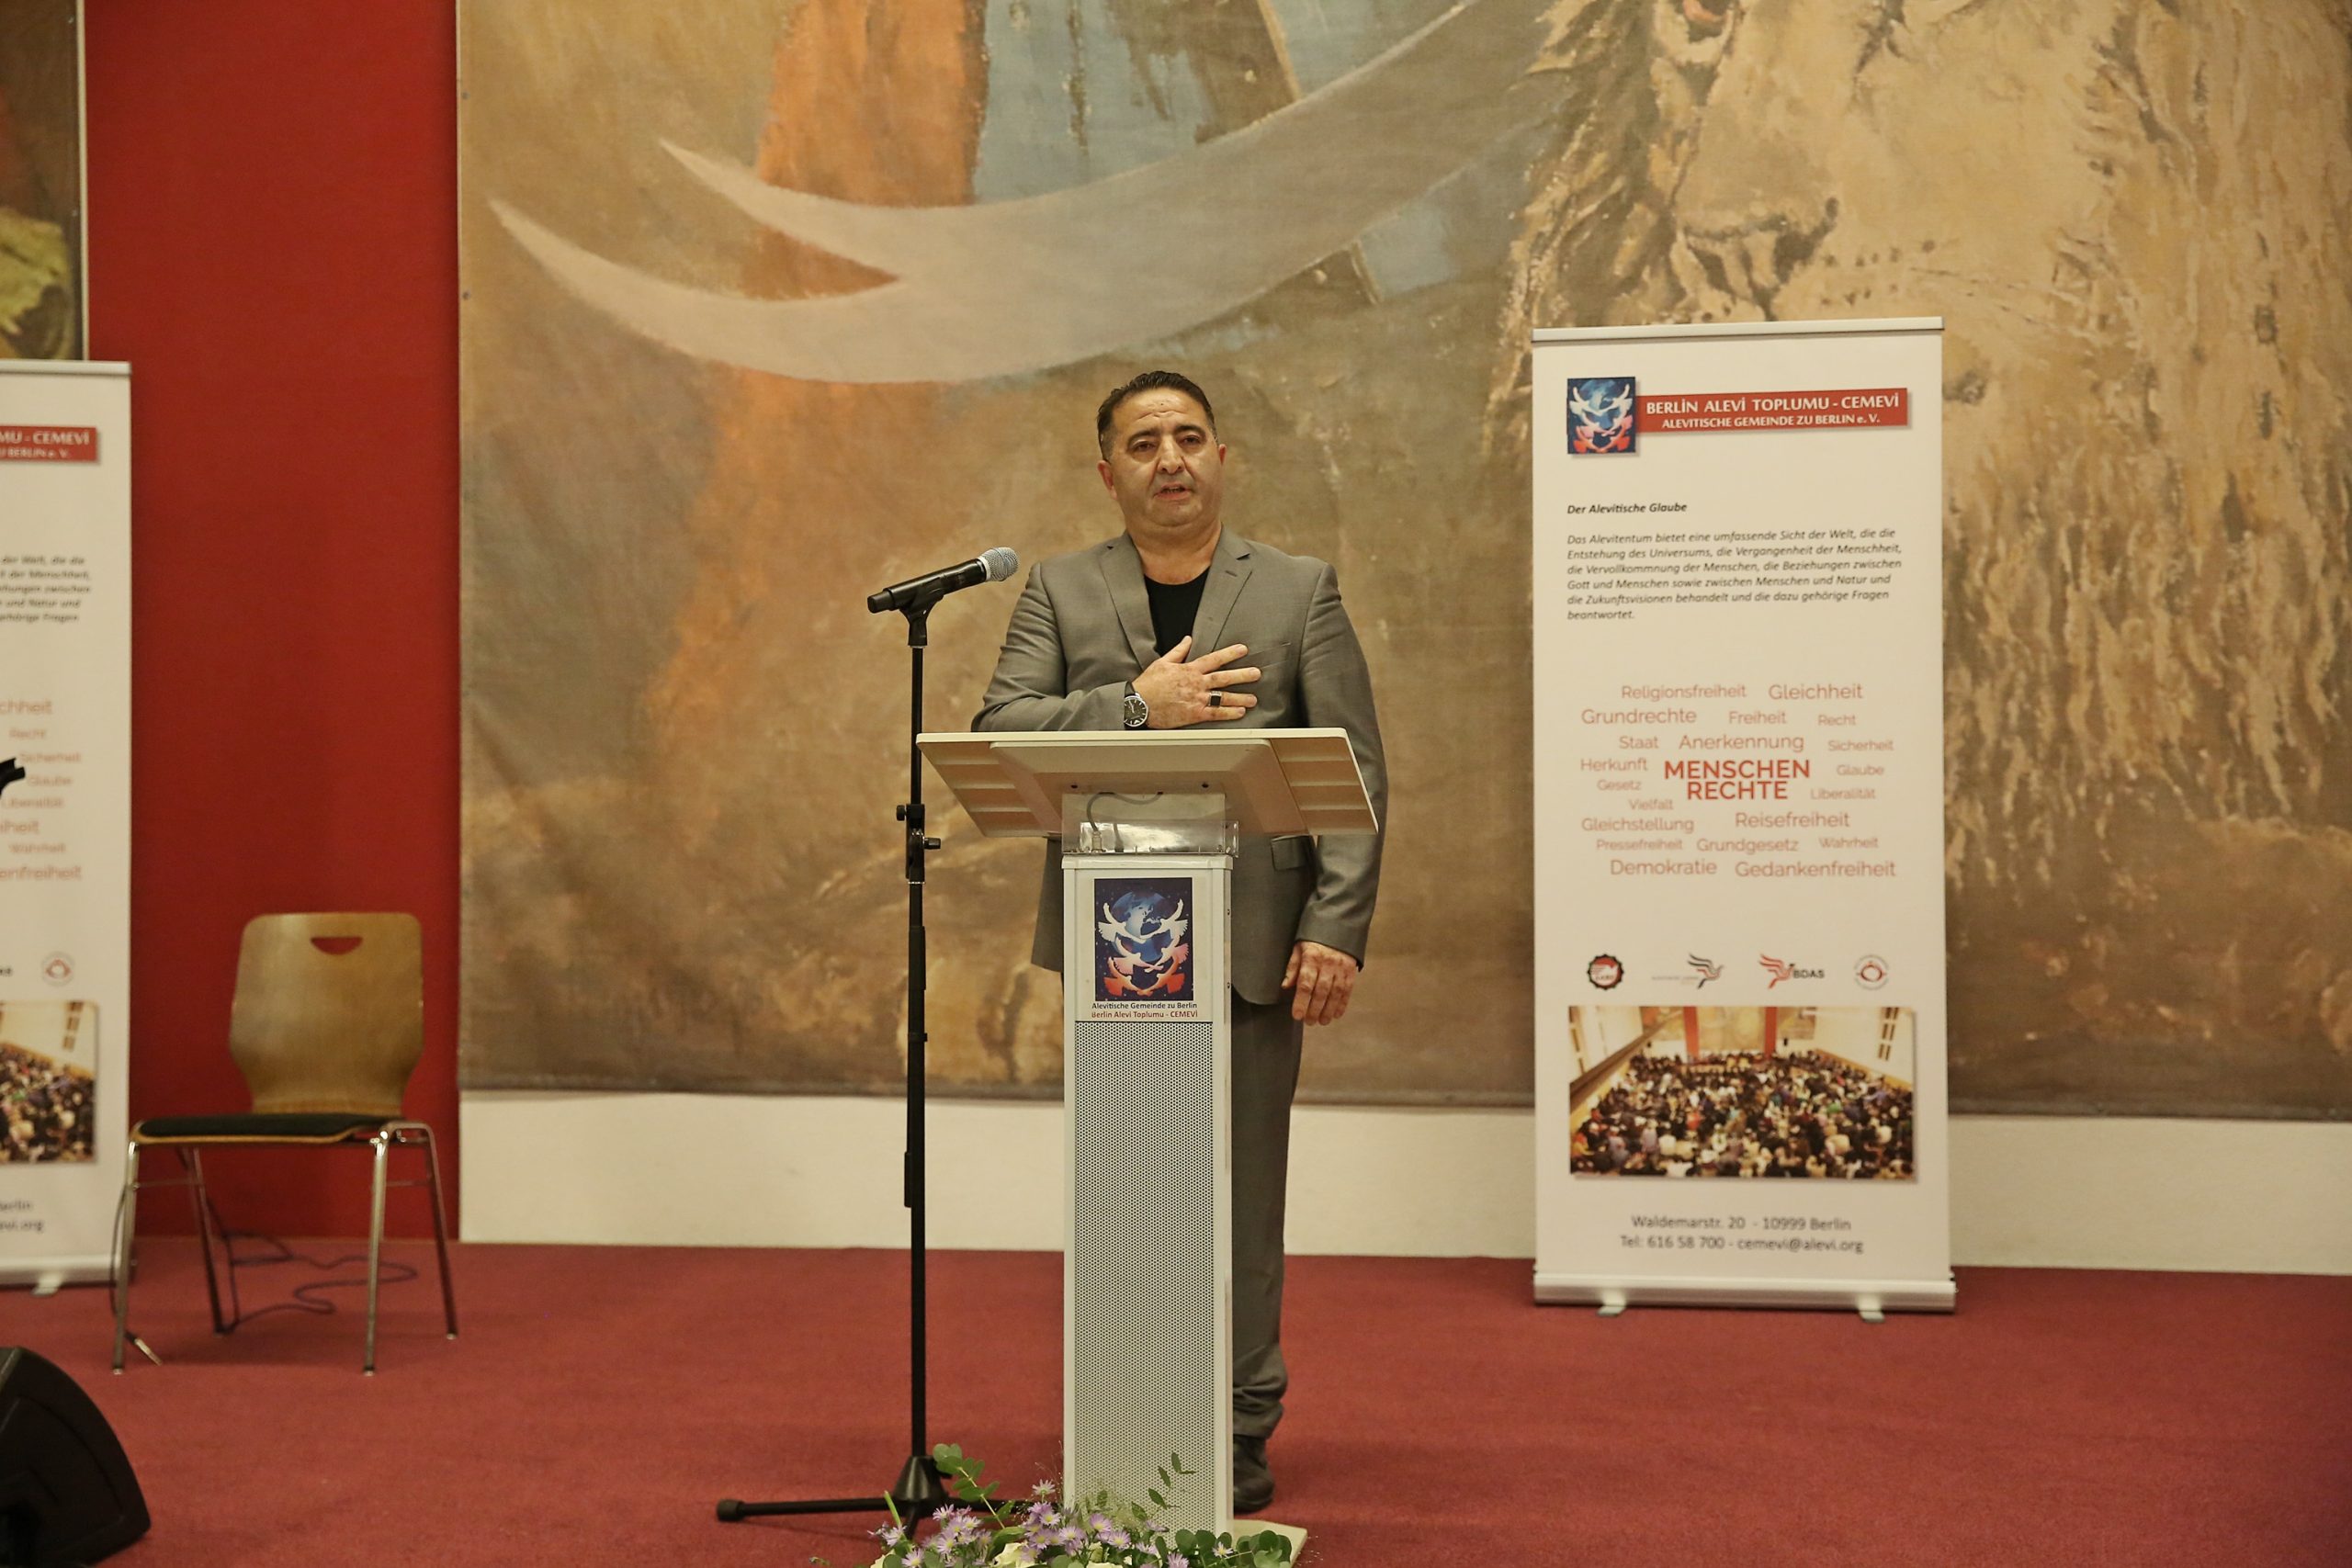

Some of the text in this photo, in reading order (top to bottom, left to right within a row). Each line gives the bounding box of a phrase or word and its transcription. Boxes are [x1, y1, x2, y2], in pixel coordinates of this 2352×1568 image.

[1646, 399, 1698, 414] BERLİN
[1704, 397, 1746, 412] ALEVİ
[1752, 397, 1829, 412] TOPLUMU
[1840, 392, 1899, 409] CEMEVİ
[1662, 413, 1881, 429] ALEVITISCHE GEMEINDE ZU BERLIN e. V.
[1567, 502, 1688, 514] Der Alevitische Glaube
[1567, 535, 1587, 545] Das
[1589, 534, 1653, 544] Alevitentum
[1656, 533, 1686, 543] bietet
[1689, 534, 1711, 542] eine
[1713, 531, 1777, 543] umfassende
[1780, 530, 1805, 540] Sicht
[1808, 530, 1826, 539] der
[1860, 528, 1876, 538] die
[1879, 528, 1895, 538] die
[1567, 549, 1626, 560] Entstehung
[1628, 548, 1646, 558] des
[1716, 547, 1733, 557] die
[1736, 546, 1813, 558] Vergangenheit
[1815, 546, 1834, 555] der
[1567, 565, 1584, 575] die
[1682, 563, 1701, 573] der
[1763, 561, 1780, 570] die
[1782, 559, 1850, 571] Beziehungen
[1853, 559, 1902, 570] zwischen
[1567, 574, 1892, 590] Gott und Menschen sowie zwischen Menschen und Natur und
[1567, 594, 1584, 604] die
[1675, 592, 1729, 603] behandelt
[1731, 592, 1752, 602] und
[1754, 592, 1770, 602] die
[1773, 592, 1799, 601] dazu
[1851, 590, 1890, 602] Fragen
[1621, 685, 1747, 702] Religionsfreiheit
[1768, 683, 1864, 700] Gleichheit
[1581, 708, 1698, 724] Grundrechte
[1728, 711, 1787, 725] Freiheit
[1817, 714, 1857, 726] Recht
[1619, 736, 1659, 750] Staat
[1679, 734, 1805, 753] Anerkennung
[1827, 739, 1894, 751] Sicherheit
[1580, 757, 1648, 772] Herkunft
[1664, 759, 1811, 780] MENSCHEN
[1836, 763, 1885, 776] Glaube
[1597, 778, 1643, 791] Gesetz
[1687, 781, 1789, 800] RECHTE
[1810, 787, 1877, 800] Liberalität
[1628, 798, 1674, 810] Vielfalt
[1581, 817, 1695, 834] Gleichstellung
[1735, 811, 1850, 828] Reisefreiheit
[1596, 839, 1683, 851] Pressefreiheit
[1696, 837, 1800, 855] Grundgesetz
[1818, 836, 1880, 849] Wahrheit
[1610, 859, 1718, 875] Demokratie
[1735, 861, 1897, 877] Gedankenfreiheit
[1793, 969, 1825, 979] BDAS
[1091, 1001, 1129, 1010] Alevitische
[1130, 1001, 1166, 1010] Gemeinde
[1133, 1010, 1164, 1020] Toplumu
[1728, 1217, 1746, 1229] 20
[1763, 1217, 1806, 1231] 10999
[1810, 1217, 1851, 1231] Berlin
[1646, 1236, 1674, 1248] 616
[1678, 1236, 1695, 1248] 58
[1700, 1237, 1725, 1249] 700
[1736, 1238, 1864, 1254] cemevi@alevi.org
